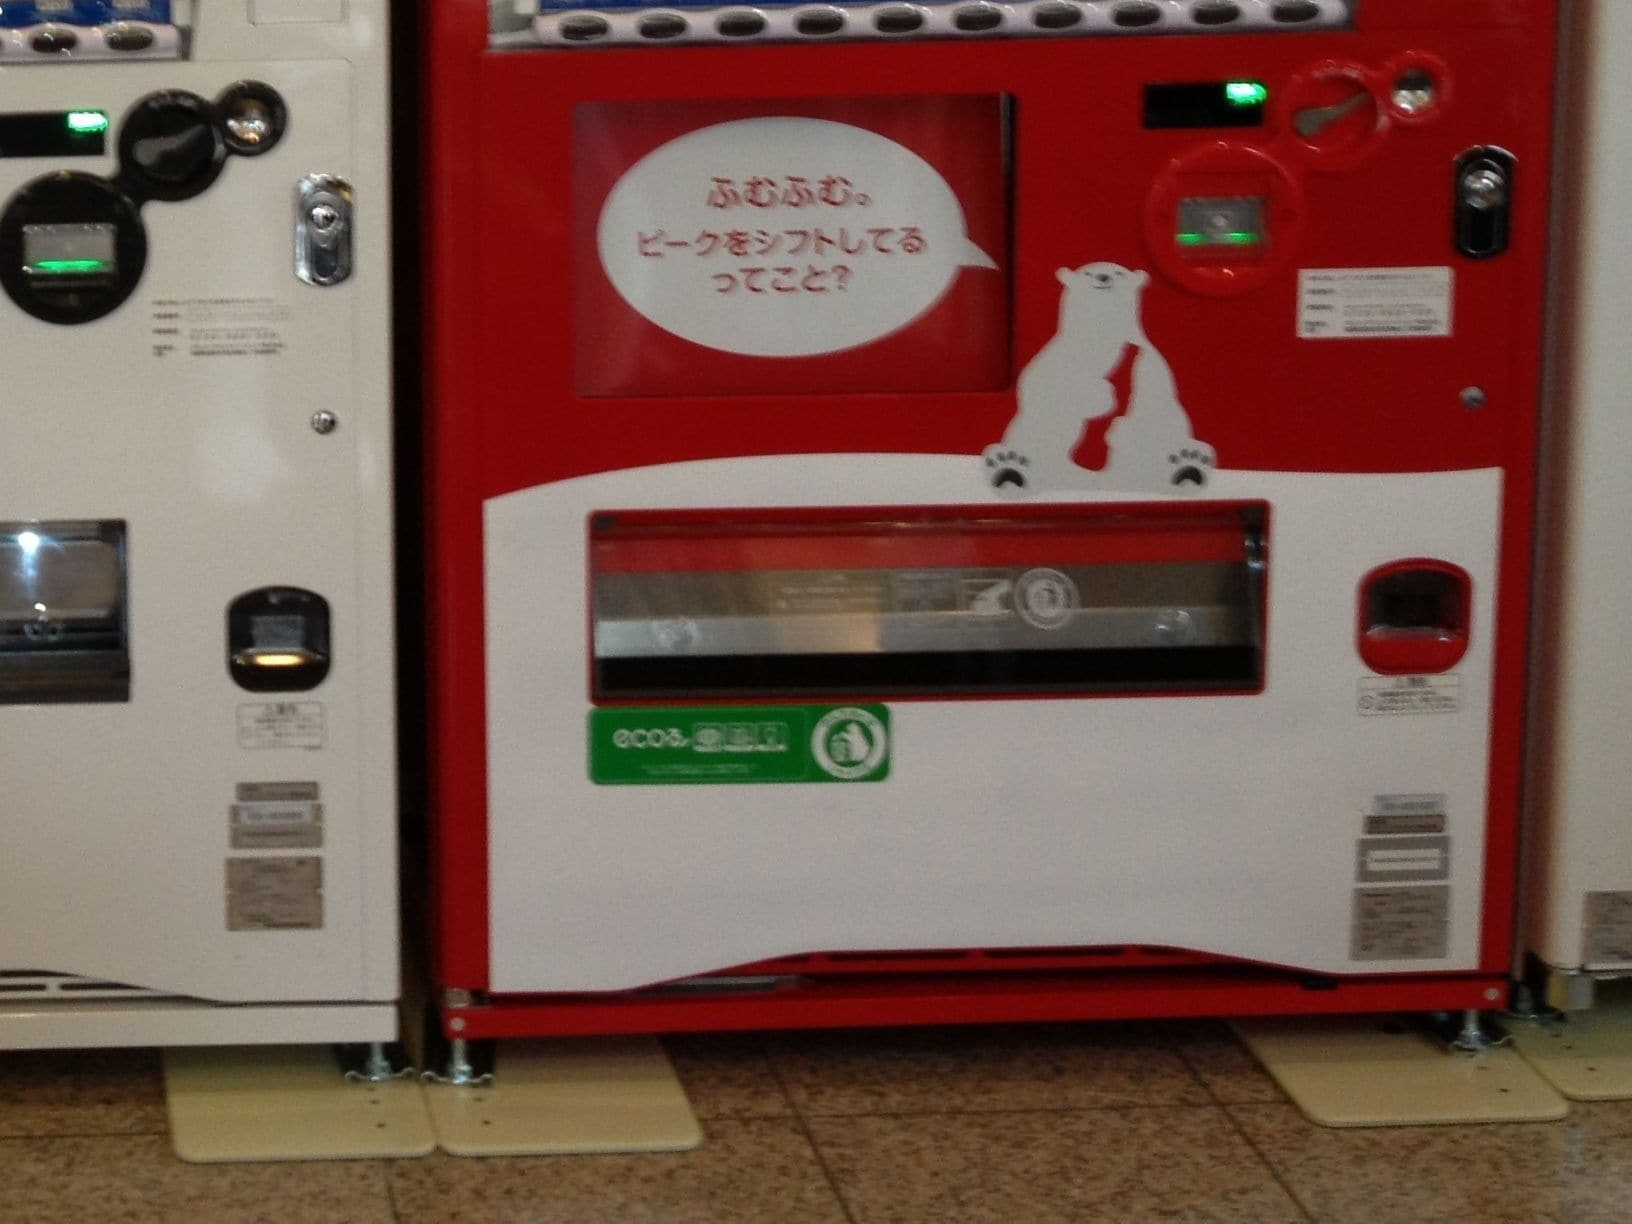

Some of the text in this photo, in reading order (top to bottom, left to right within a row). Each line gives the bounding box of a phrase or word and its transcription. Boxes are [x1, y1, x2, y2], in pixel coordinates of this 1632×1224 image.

[706, 175, 872, 209] ふむふむ。
[637, 226, 928, 258] ピークをシフトしてる
